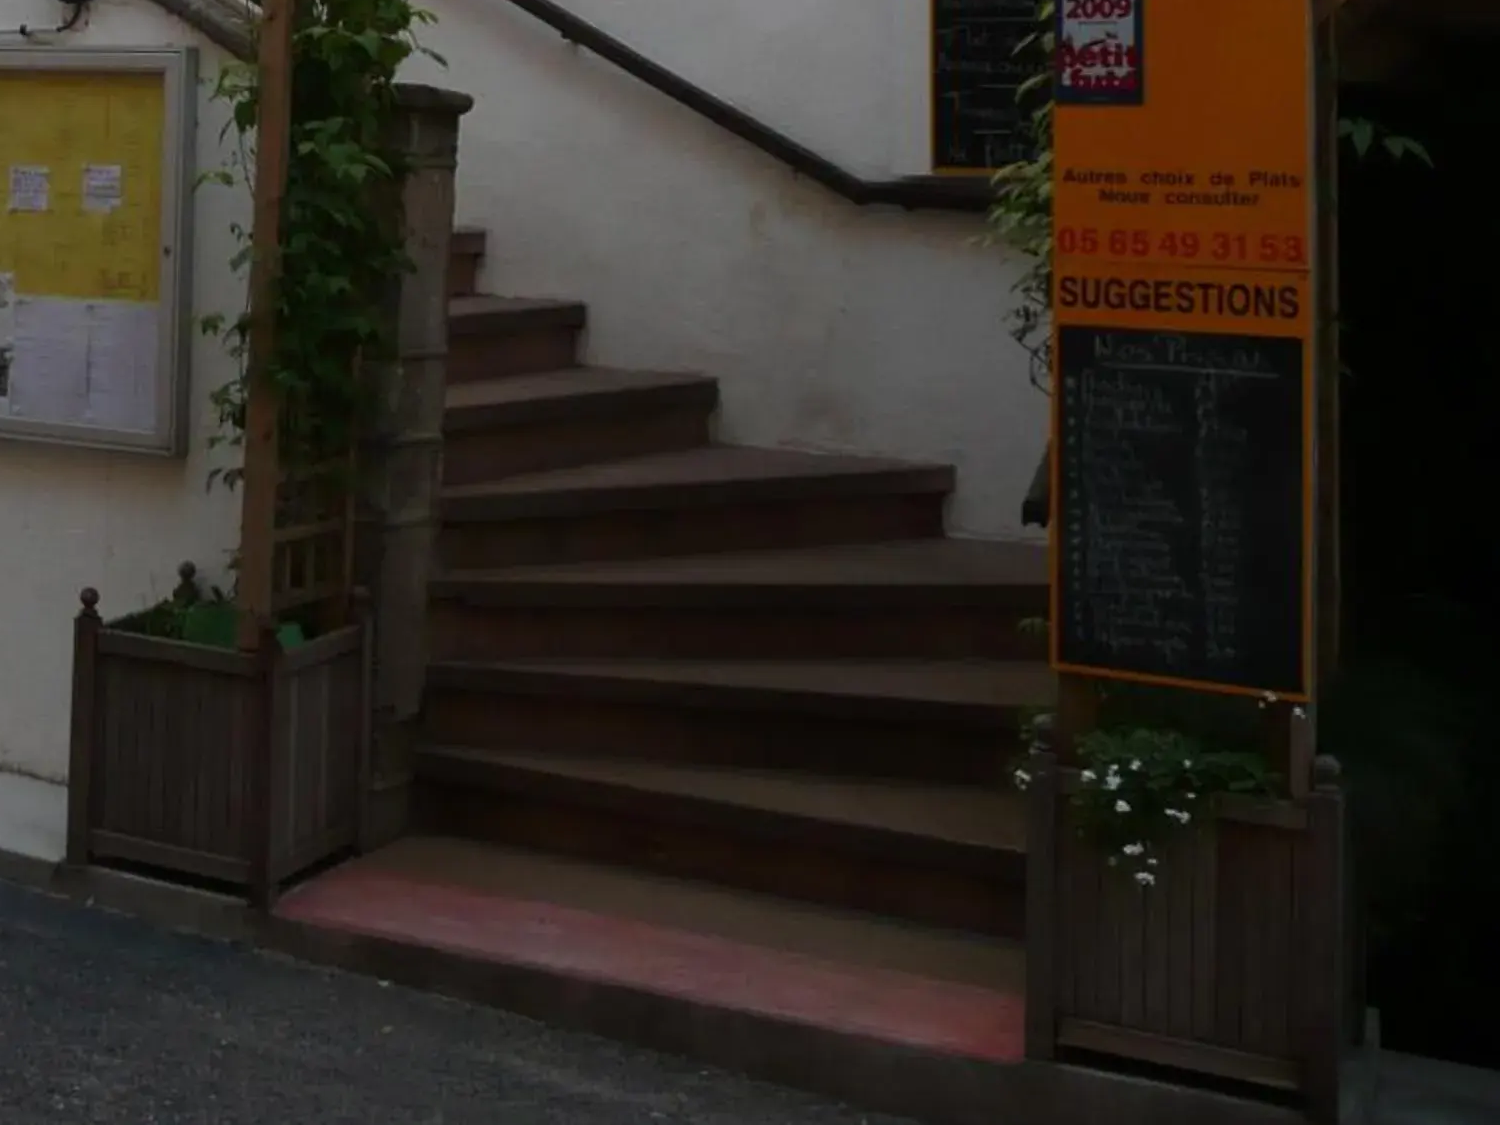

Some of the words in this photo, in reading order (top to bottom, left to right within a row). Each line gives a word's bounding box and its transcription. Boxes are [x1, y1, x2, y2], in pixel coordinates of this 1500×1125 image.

[1063, 169, 1127, 186] Autres
[1140, 169, 1195, 186] choix
[1209, 171, 1234, 186] de
[1249, 171, 1301, 188] Plats
[1058, 225, 1099, 255] 05
[1158, 231, 1200, 259] 49
[1211, 231, 1247, 260] 31
[1060, 276, 1300, 318] SUGGESTIONS
